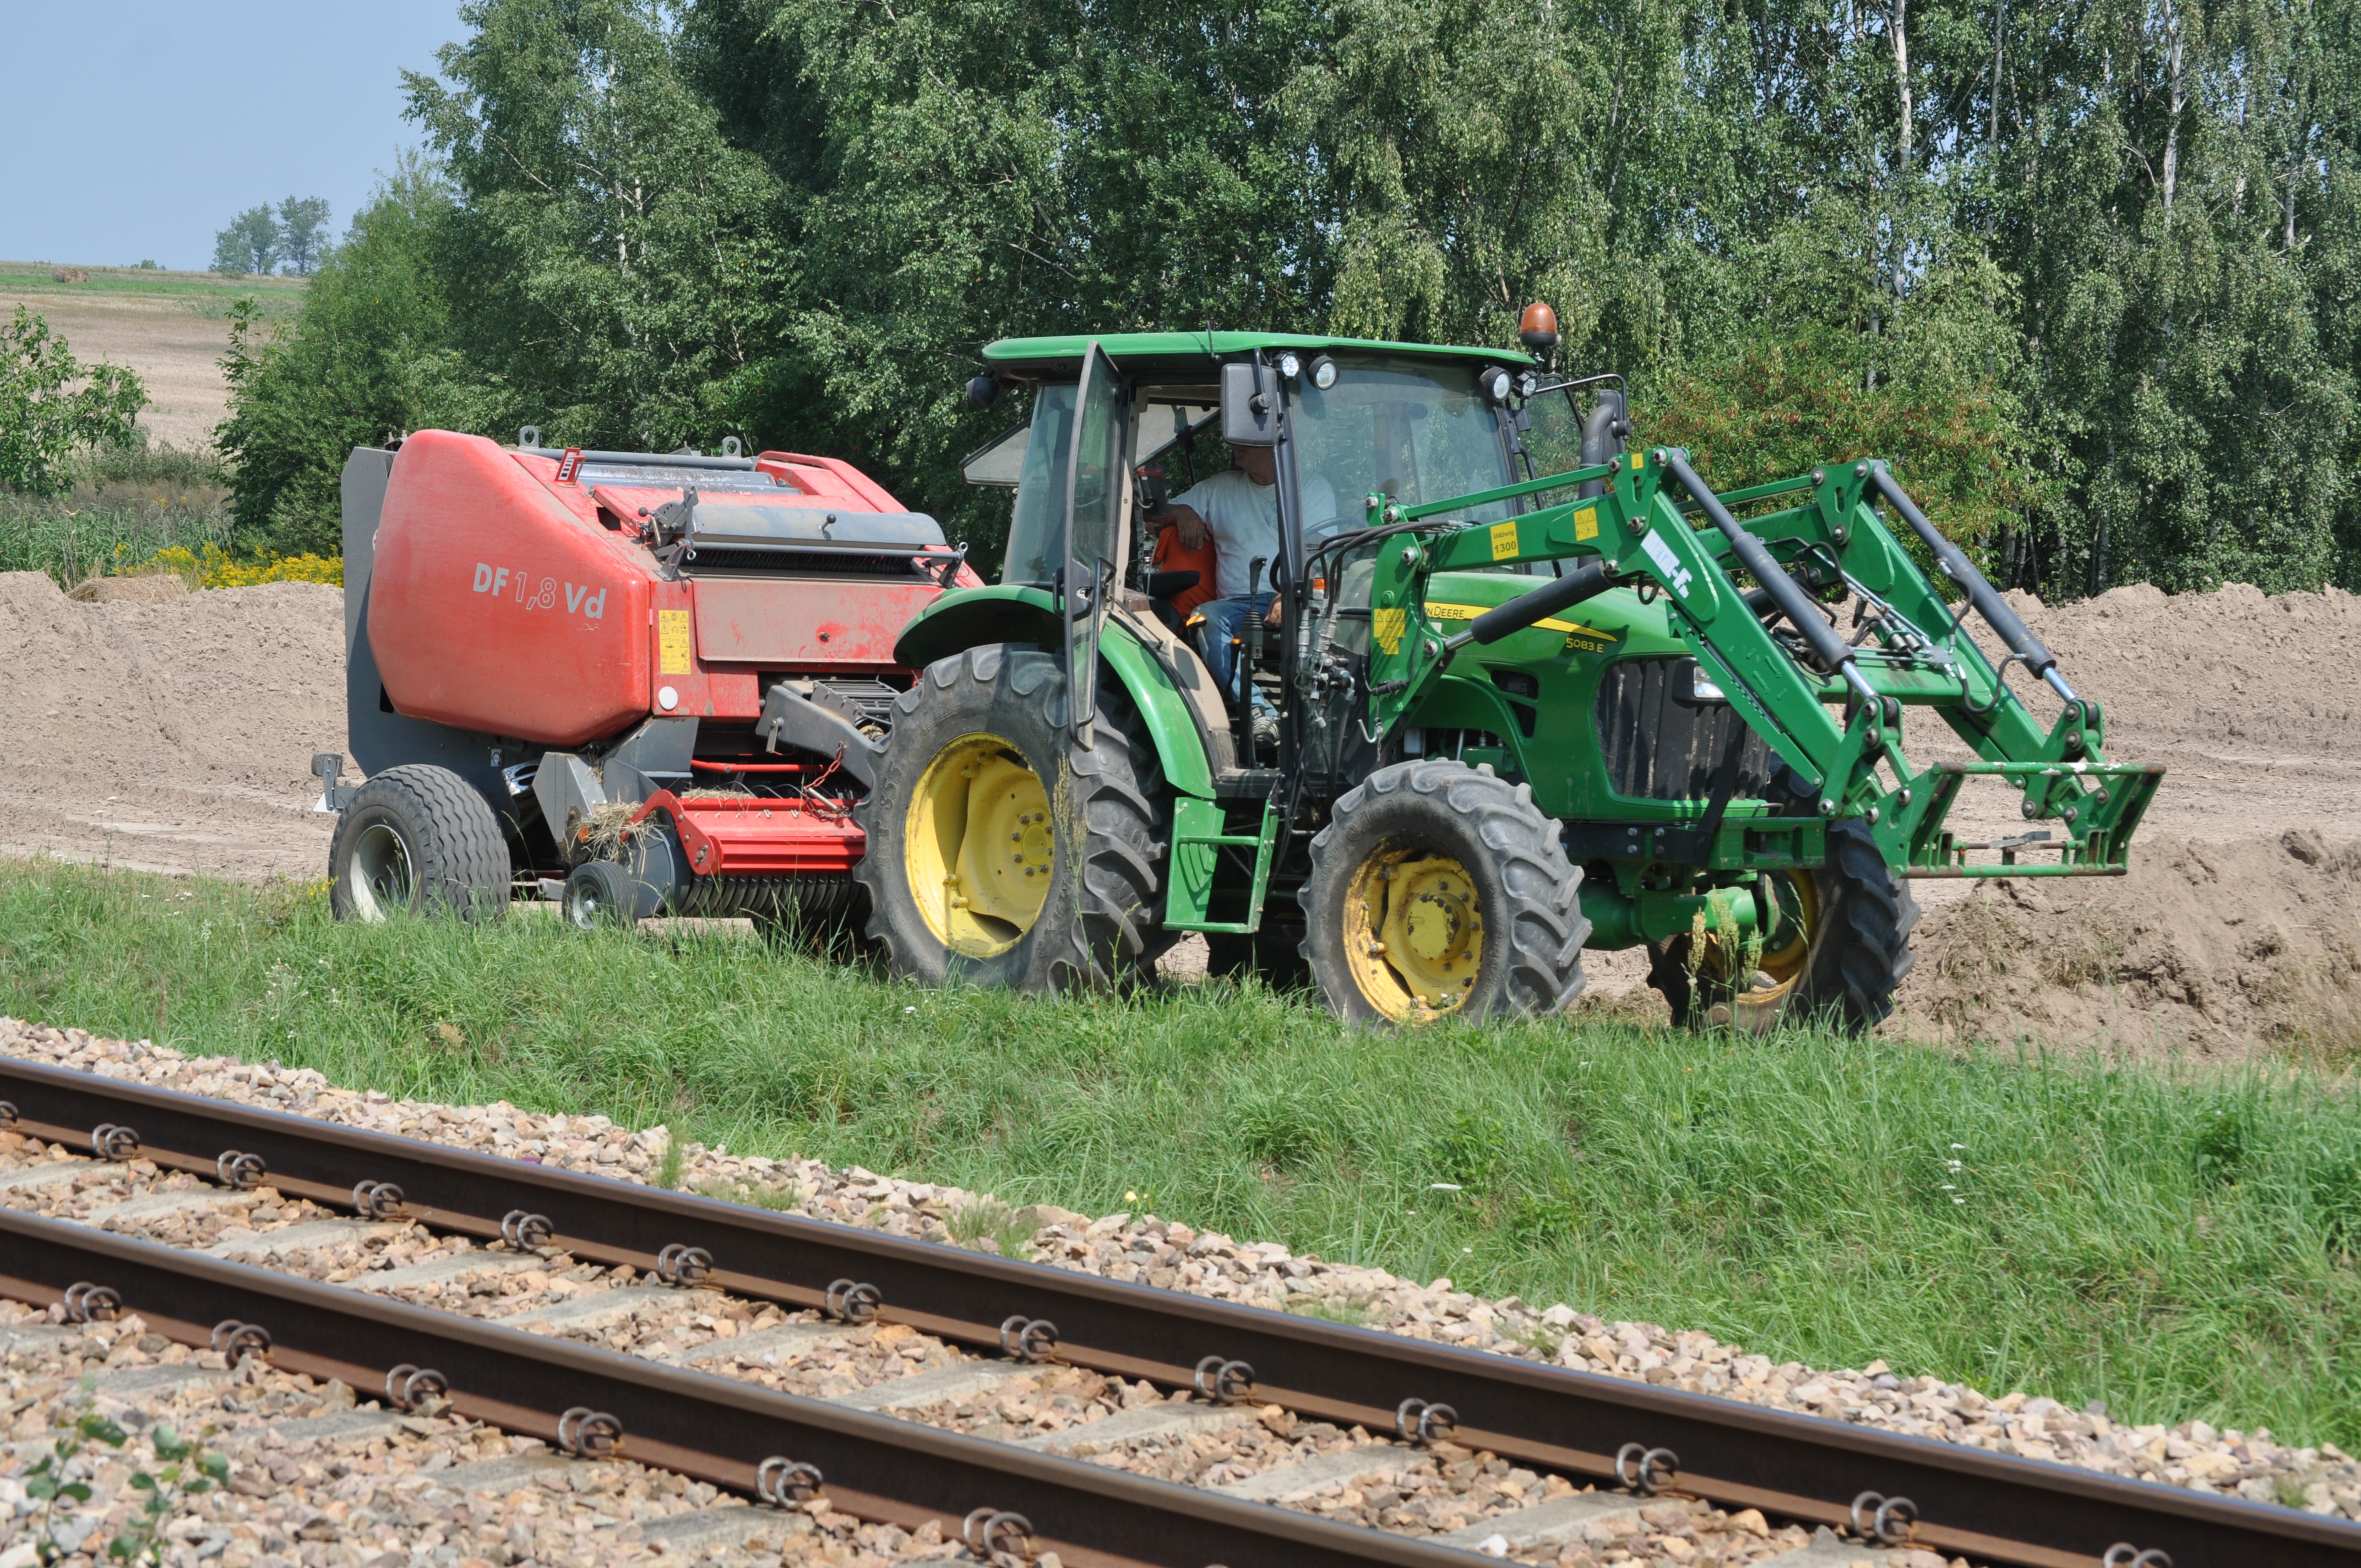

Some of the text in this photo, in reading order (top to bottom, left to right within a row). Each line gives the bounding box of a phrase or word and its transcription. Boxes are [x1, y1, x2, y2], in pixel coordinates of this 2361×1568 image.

[1494, 541, 1516, 553] 1300
[472, 562, 607, 619] DF 1,8 Vd
[1434, 606, 1465, 618] DEERE
[1566, 637, 1604, 654] 5083 E
